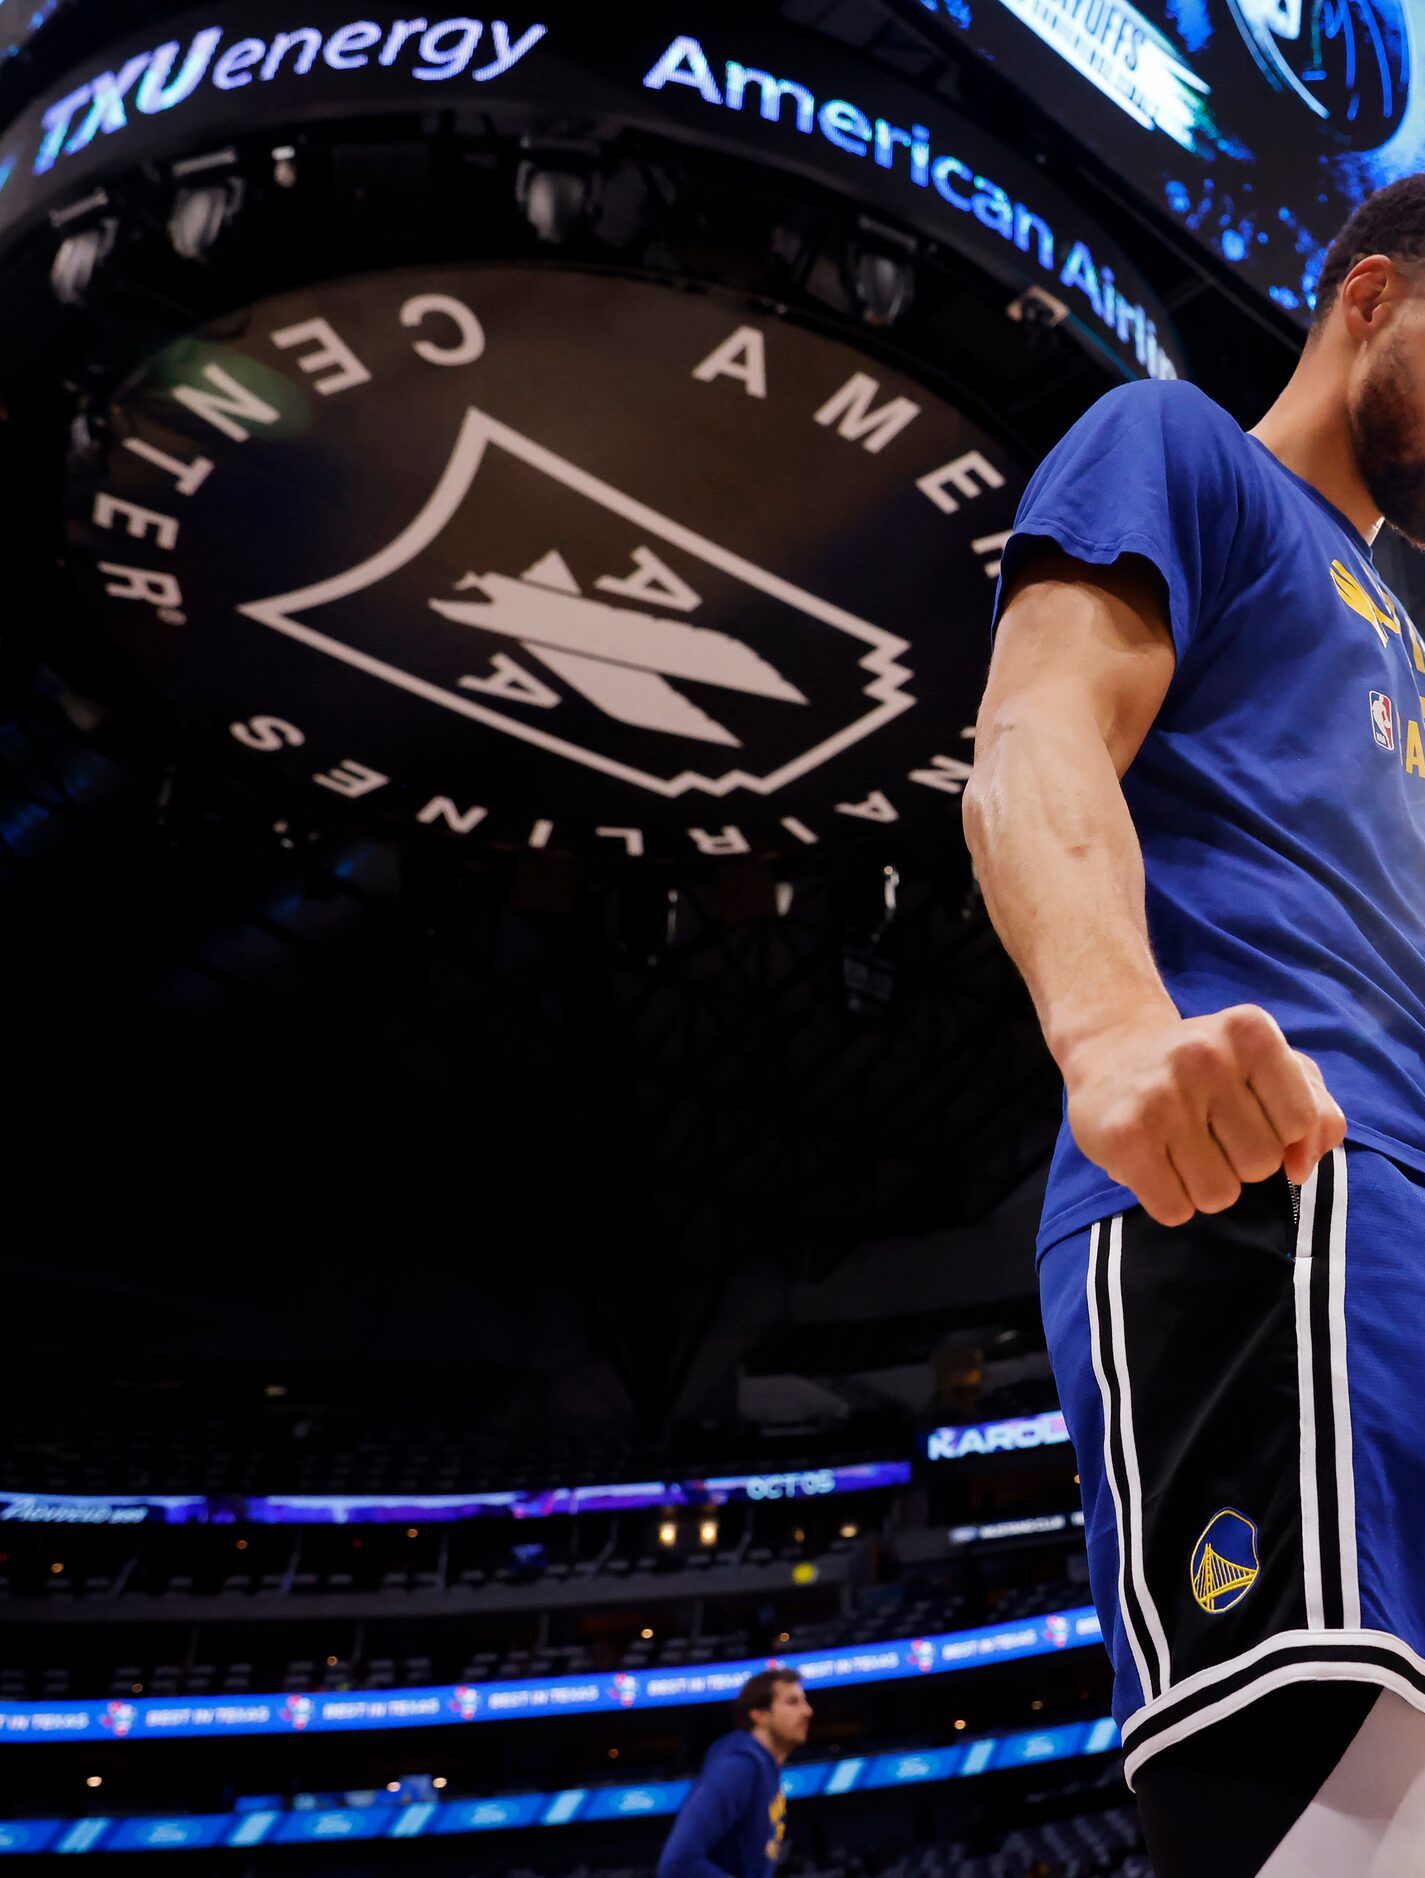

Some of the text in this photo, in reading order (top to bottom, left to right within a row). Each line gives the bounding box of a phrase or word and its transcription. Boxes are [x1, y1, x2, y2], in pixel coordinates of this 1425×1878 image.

[643, 36, 1054, 270] American
[229, 713, 901, 858] AIRLINES
[746, 1474, 797, 1500] OCT
